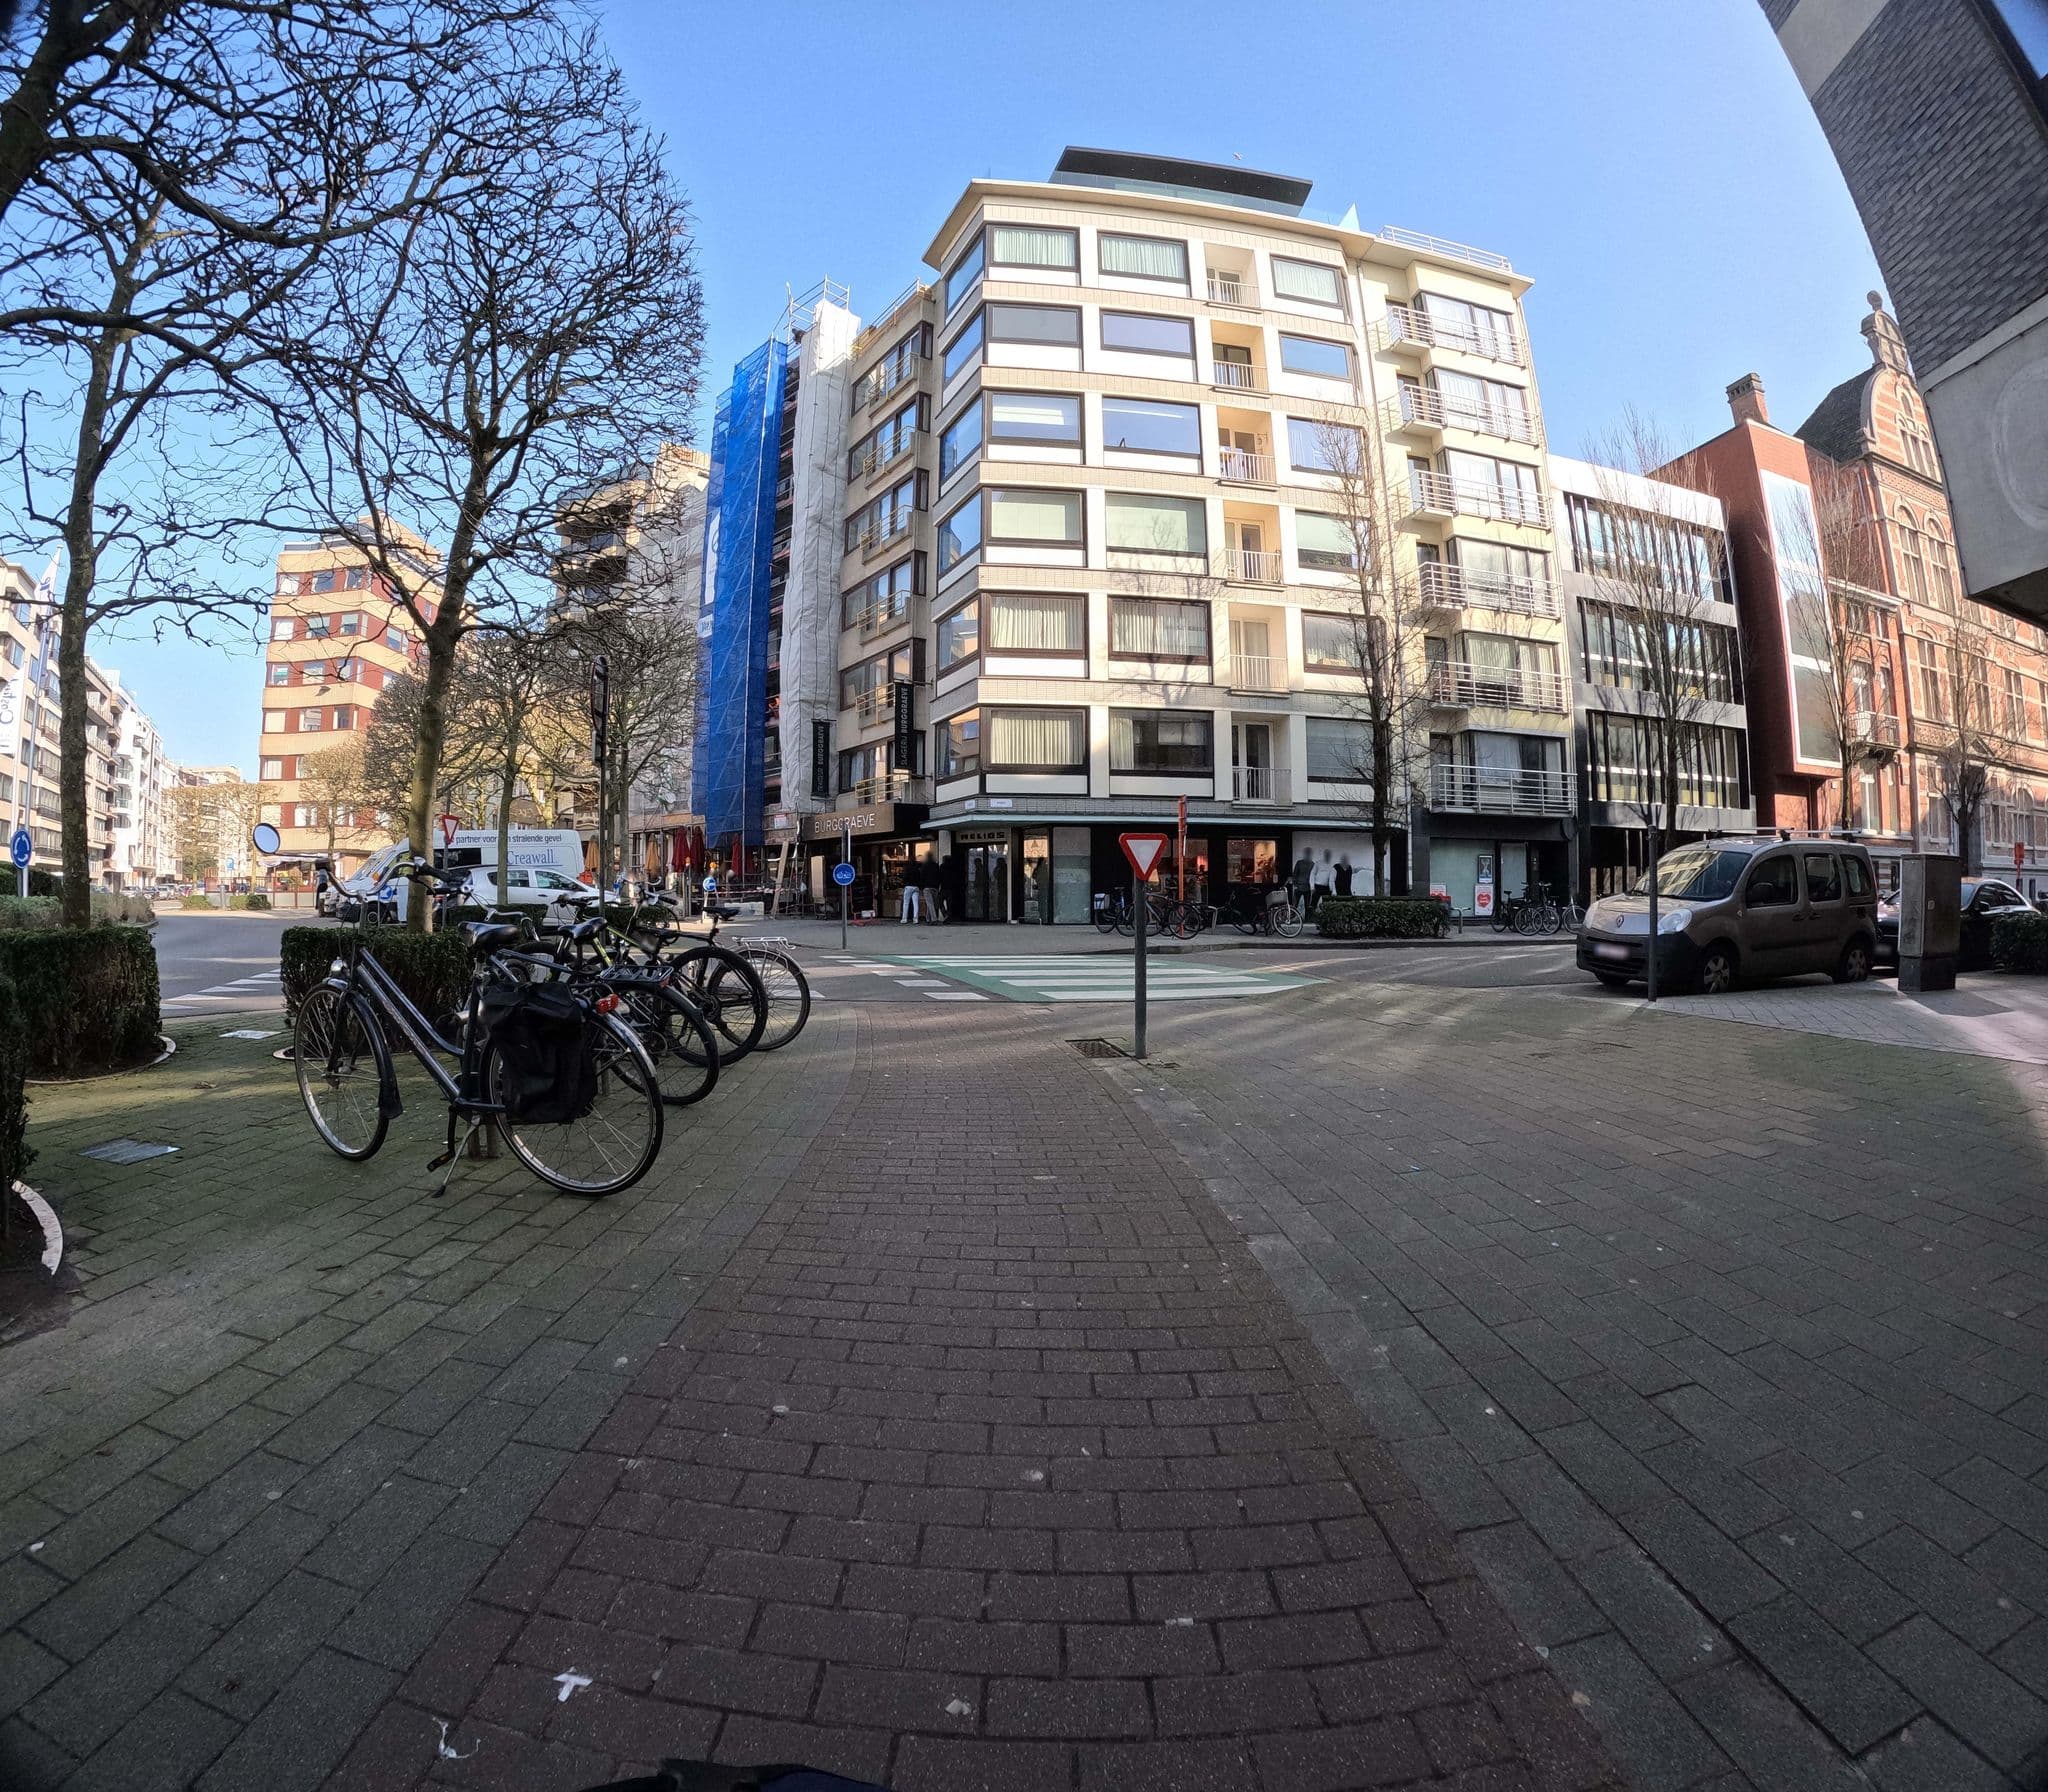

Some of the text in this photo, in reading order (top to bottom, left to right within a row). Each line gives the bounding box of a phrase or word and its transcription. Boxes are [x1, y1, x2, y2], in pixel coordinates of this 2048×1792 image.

[900, 687, 908, 733] BURGGRAEVE
[815, 813, 875, 833] BURGGRAEVE
[456, 835, 481, 845] partner
[513, 834, 543, 843] stralende
[544, 833, 562, 844] gevel
[507, 849, 554, 865] Creawall
